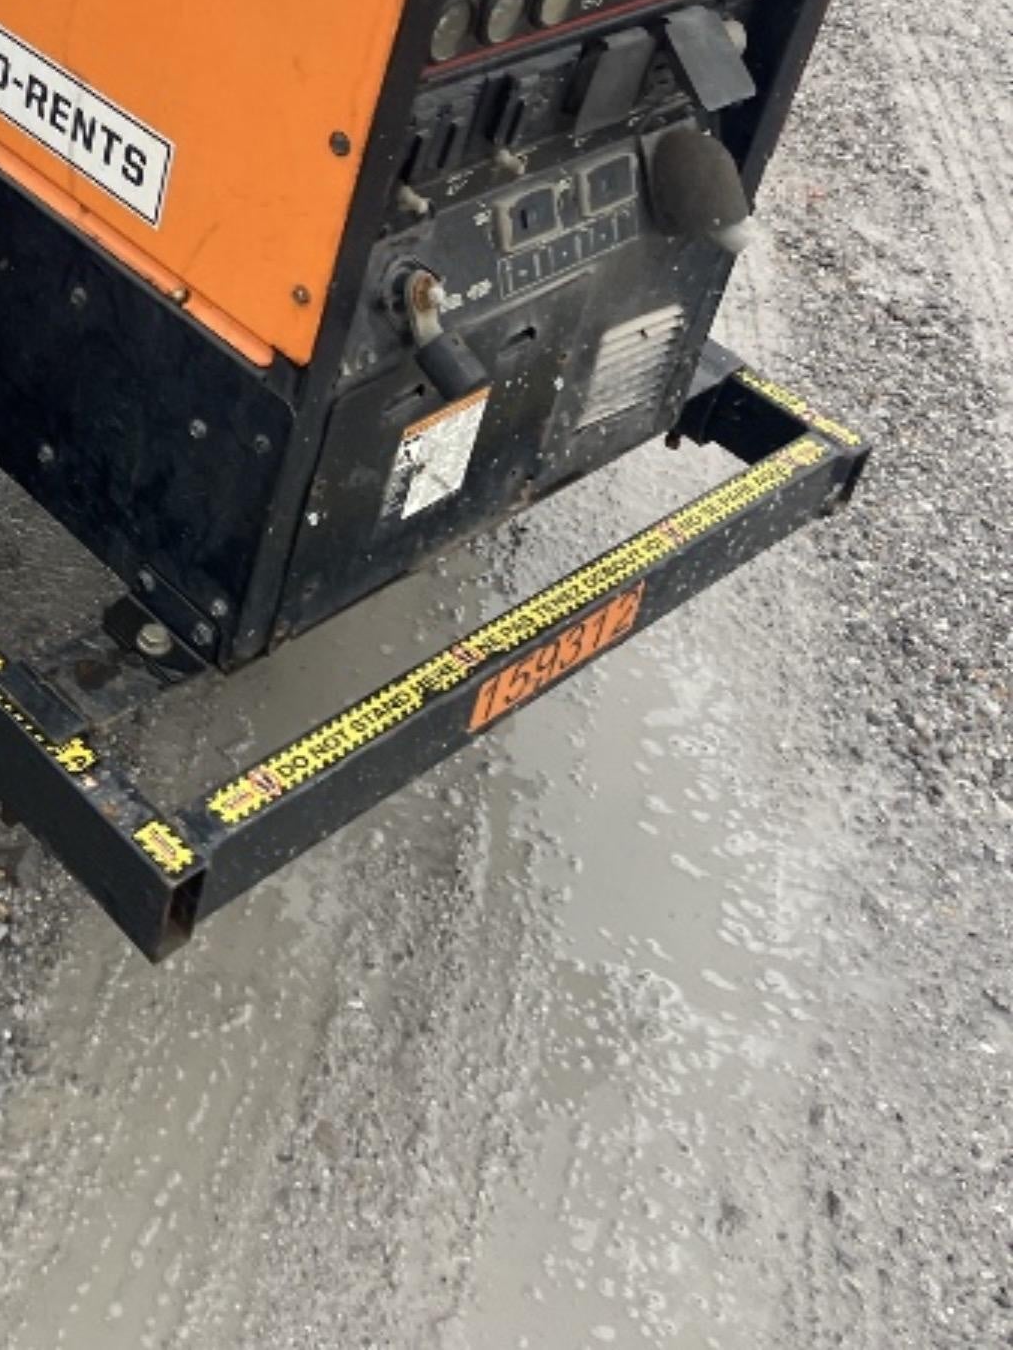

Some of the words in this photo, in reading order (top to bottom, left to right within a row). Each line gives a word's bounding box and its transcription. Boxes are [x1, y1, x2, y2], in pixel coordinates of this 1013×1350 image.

[275, 754, 310, 778] DO
[309, 726, 352, 759] NOT
[349, 690, 412, 733] STAND
